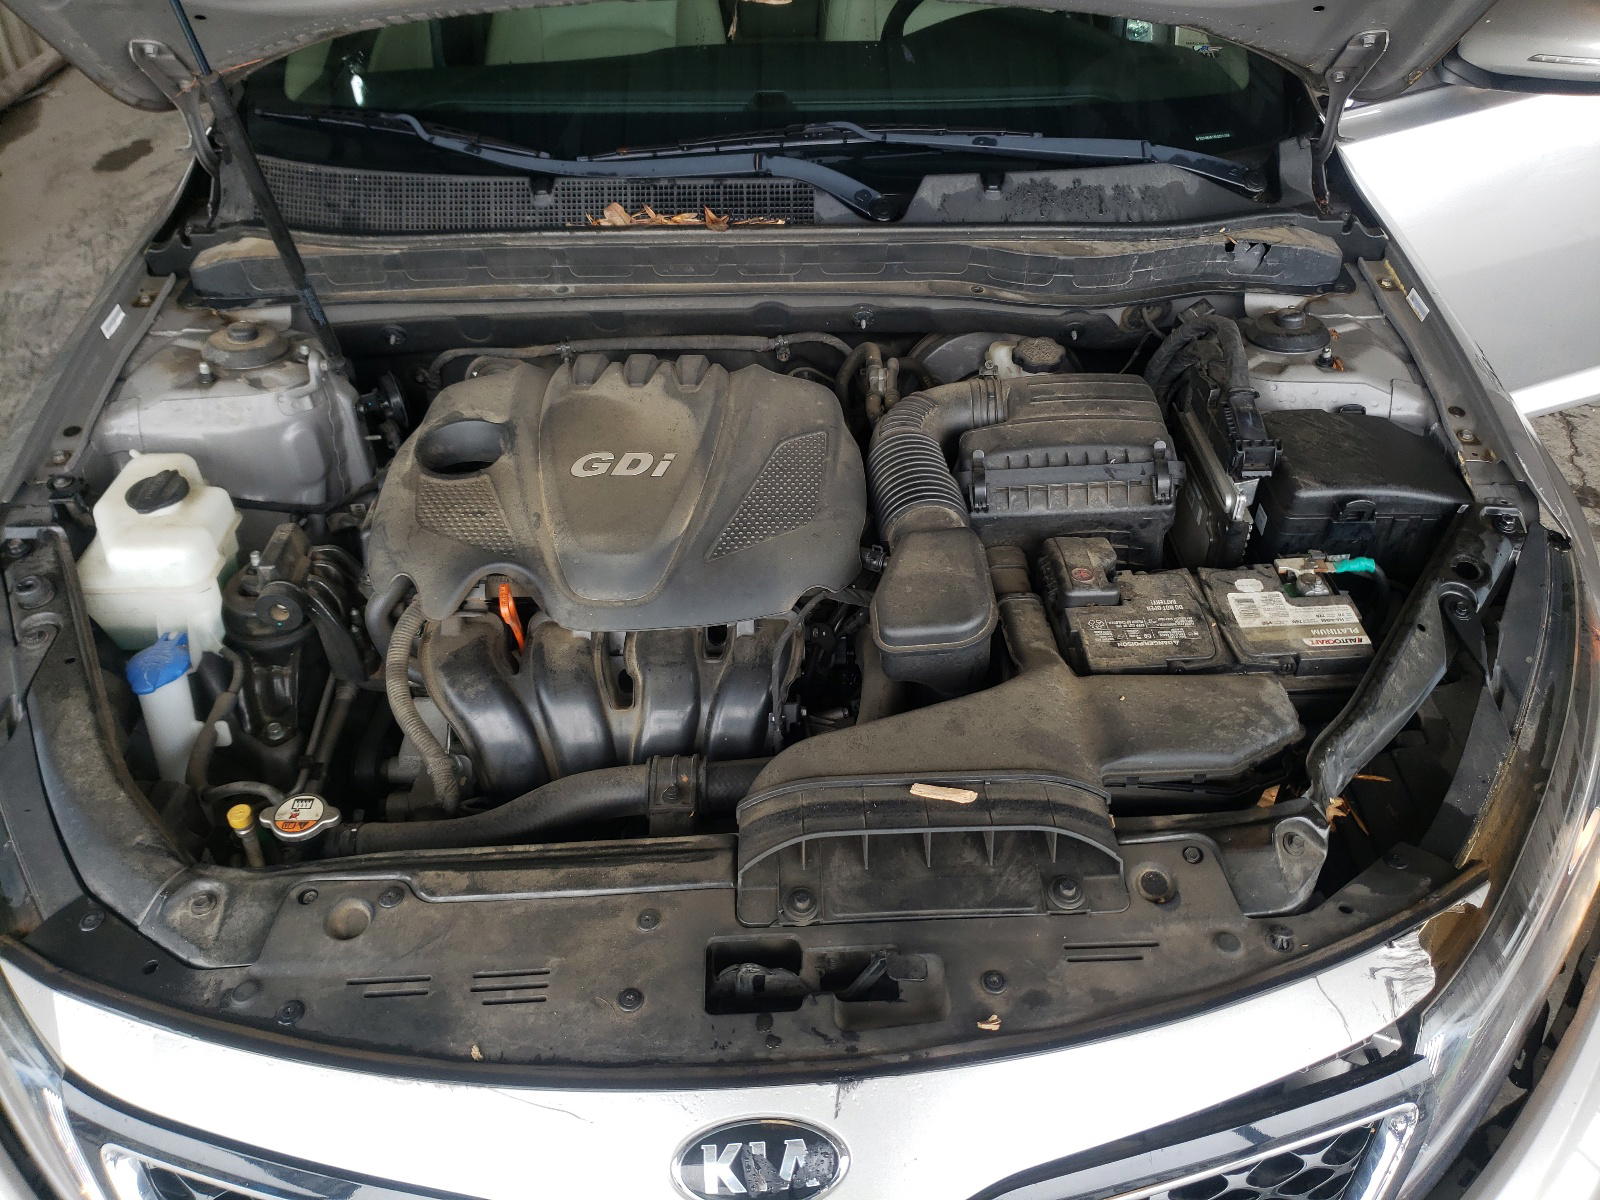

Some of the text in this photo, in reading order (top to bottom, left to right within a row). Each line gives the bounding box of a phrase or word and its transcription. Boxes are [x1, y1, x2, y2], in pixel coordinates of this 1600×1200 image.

[570, 452, 678, 478] GDi
[1311, 627, 1359, 635] PLATINUM
[1311, 637, 1359, 645] AUTOCRAFT
